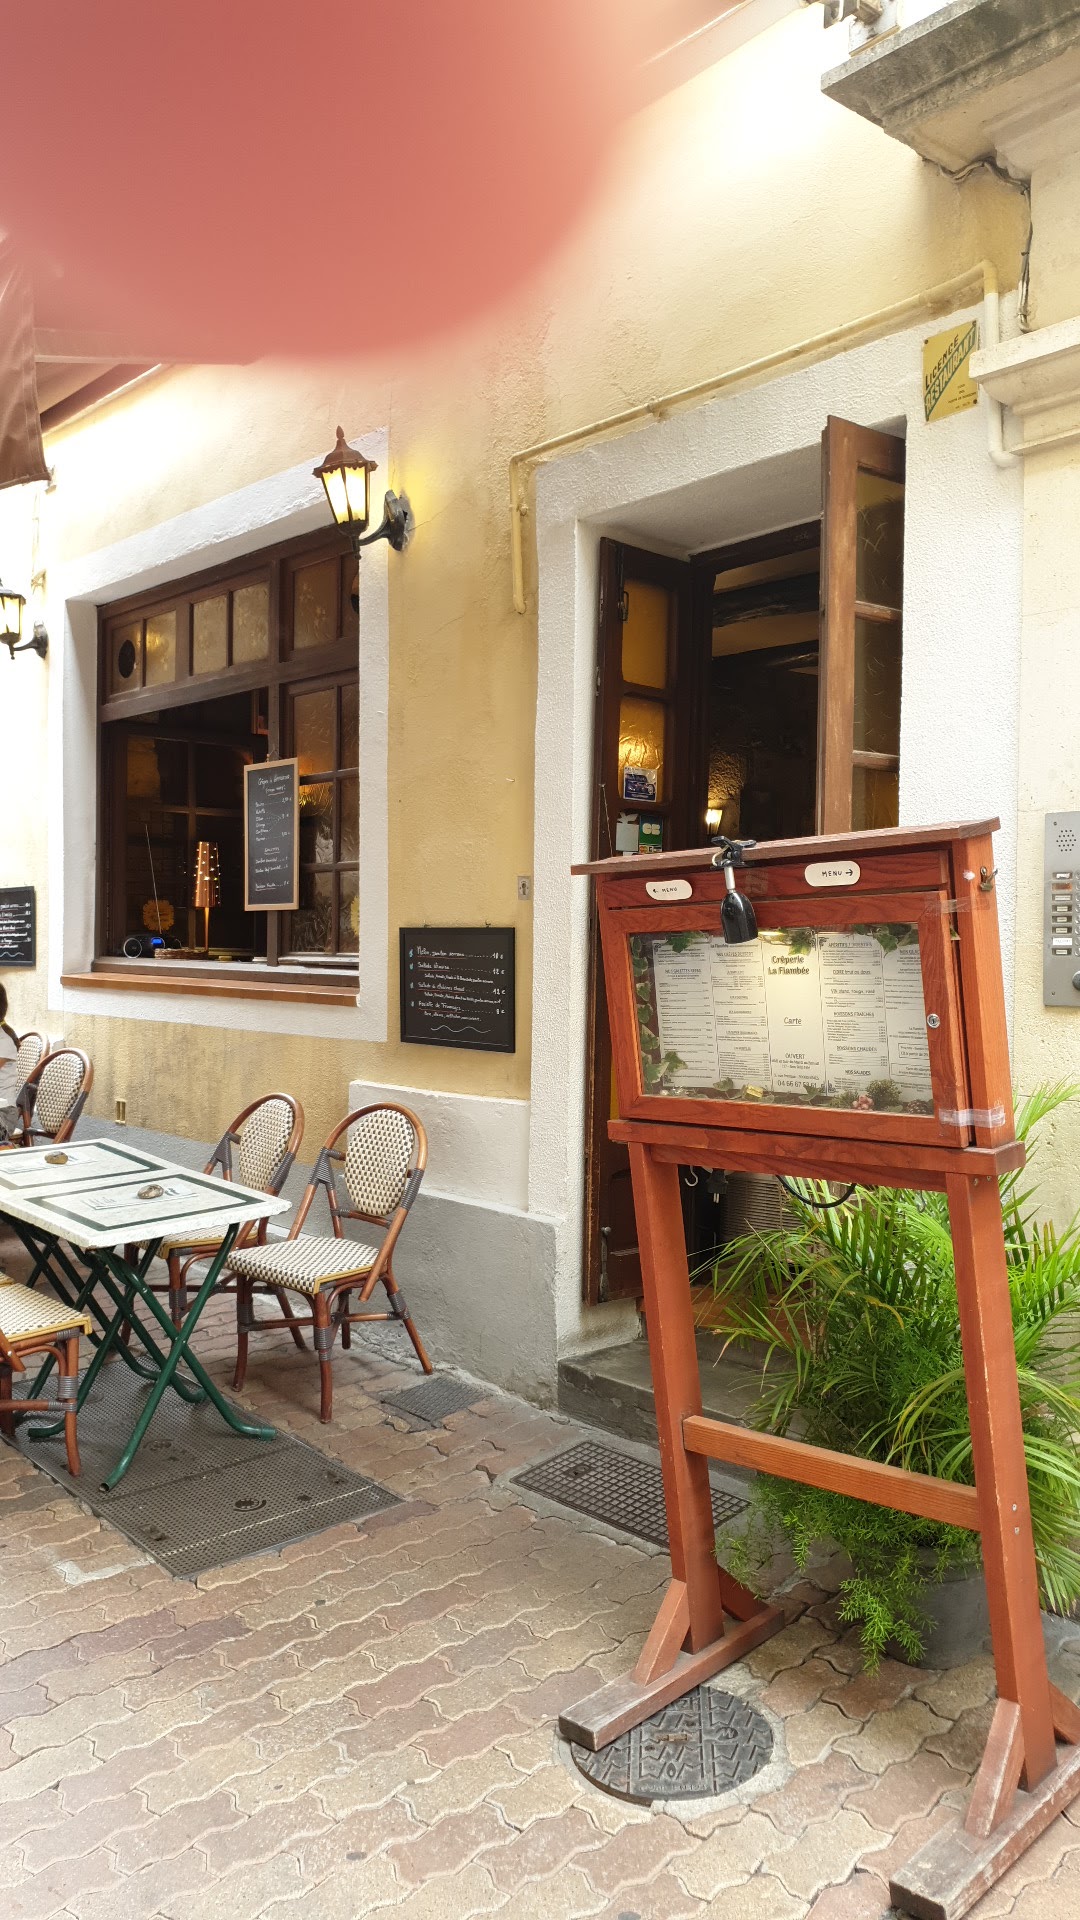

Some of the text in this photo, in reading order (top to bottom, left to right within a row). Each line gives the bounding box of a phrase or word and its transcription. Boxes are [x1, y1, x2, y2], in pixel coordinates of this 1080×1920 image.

[926, 334, 959, 391] LICENCE
[771, 955, 805, 964] Crêperie
[768, 966, 778, 975] La
[784, 1016, 802, 1025] Carte
